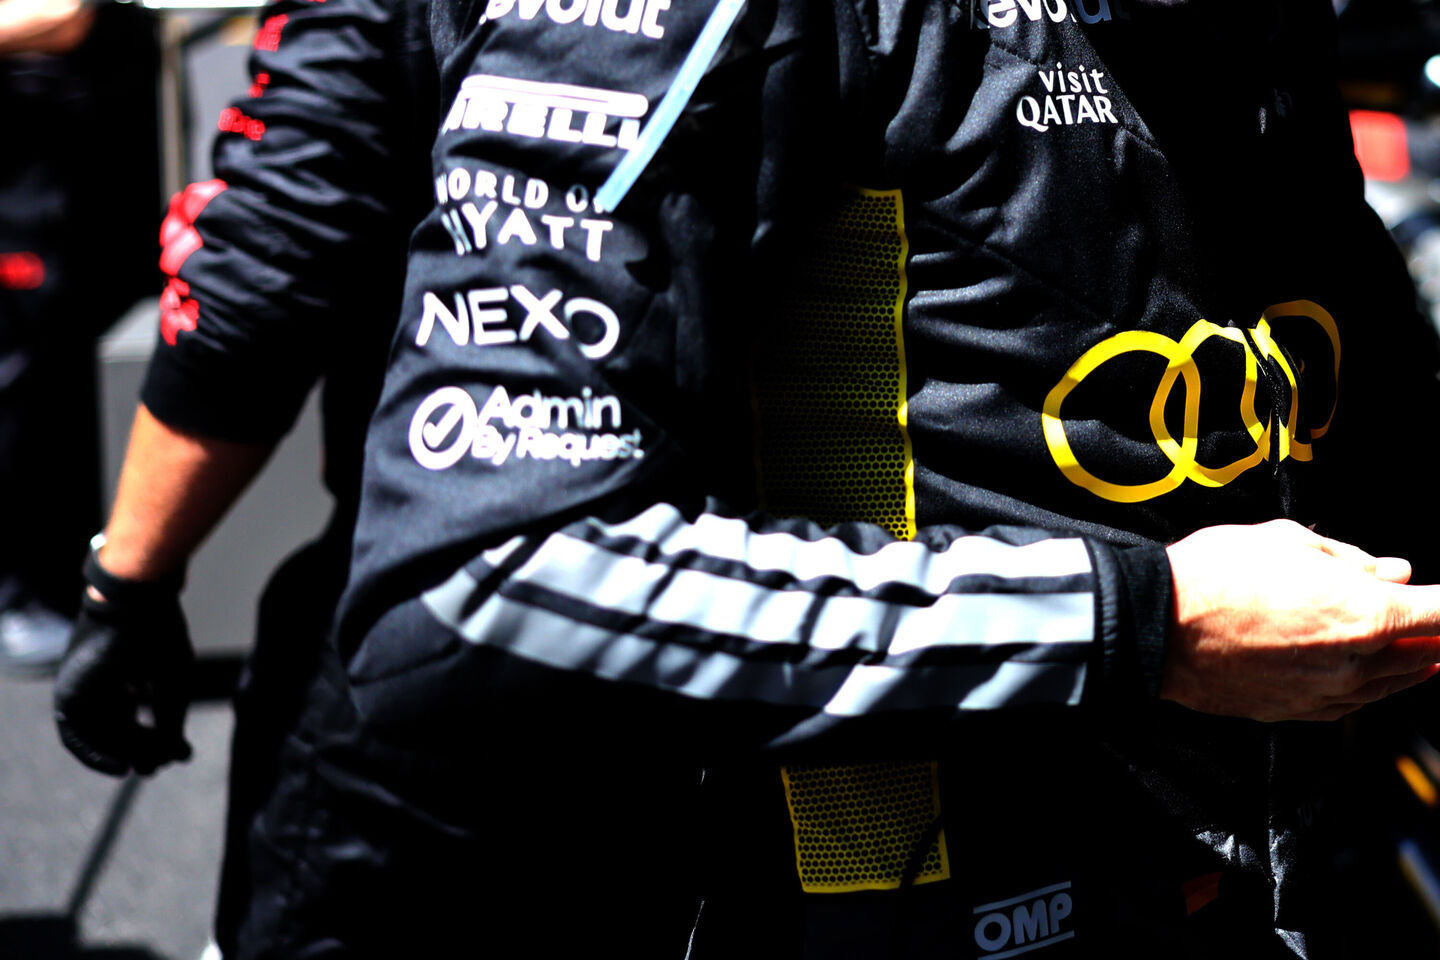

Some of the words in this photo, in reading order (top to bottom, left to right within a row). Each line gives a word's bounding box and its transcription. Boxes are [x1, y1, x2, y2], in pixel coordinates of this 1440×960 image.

[1038, 61, 1108, 94] visit
[1016, 94, 1119, 133] QATAR
[415, 284, 621, 360] NEXO
[477, 385, 622, 429] Admin
[471, 424, 516, 467] By
[974, 892, 1073, 952] OMP
